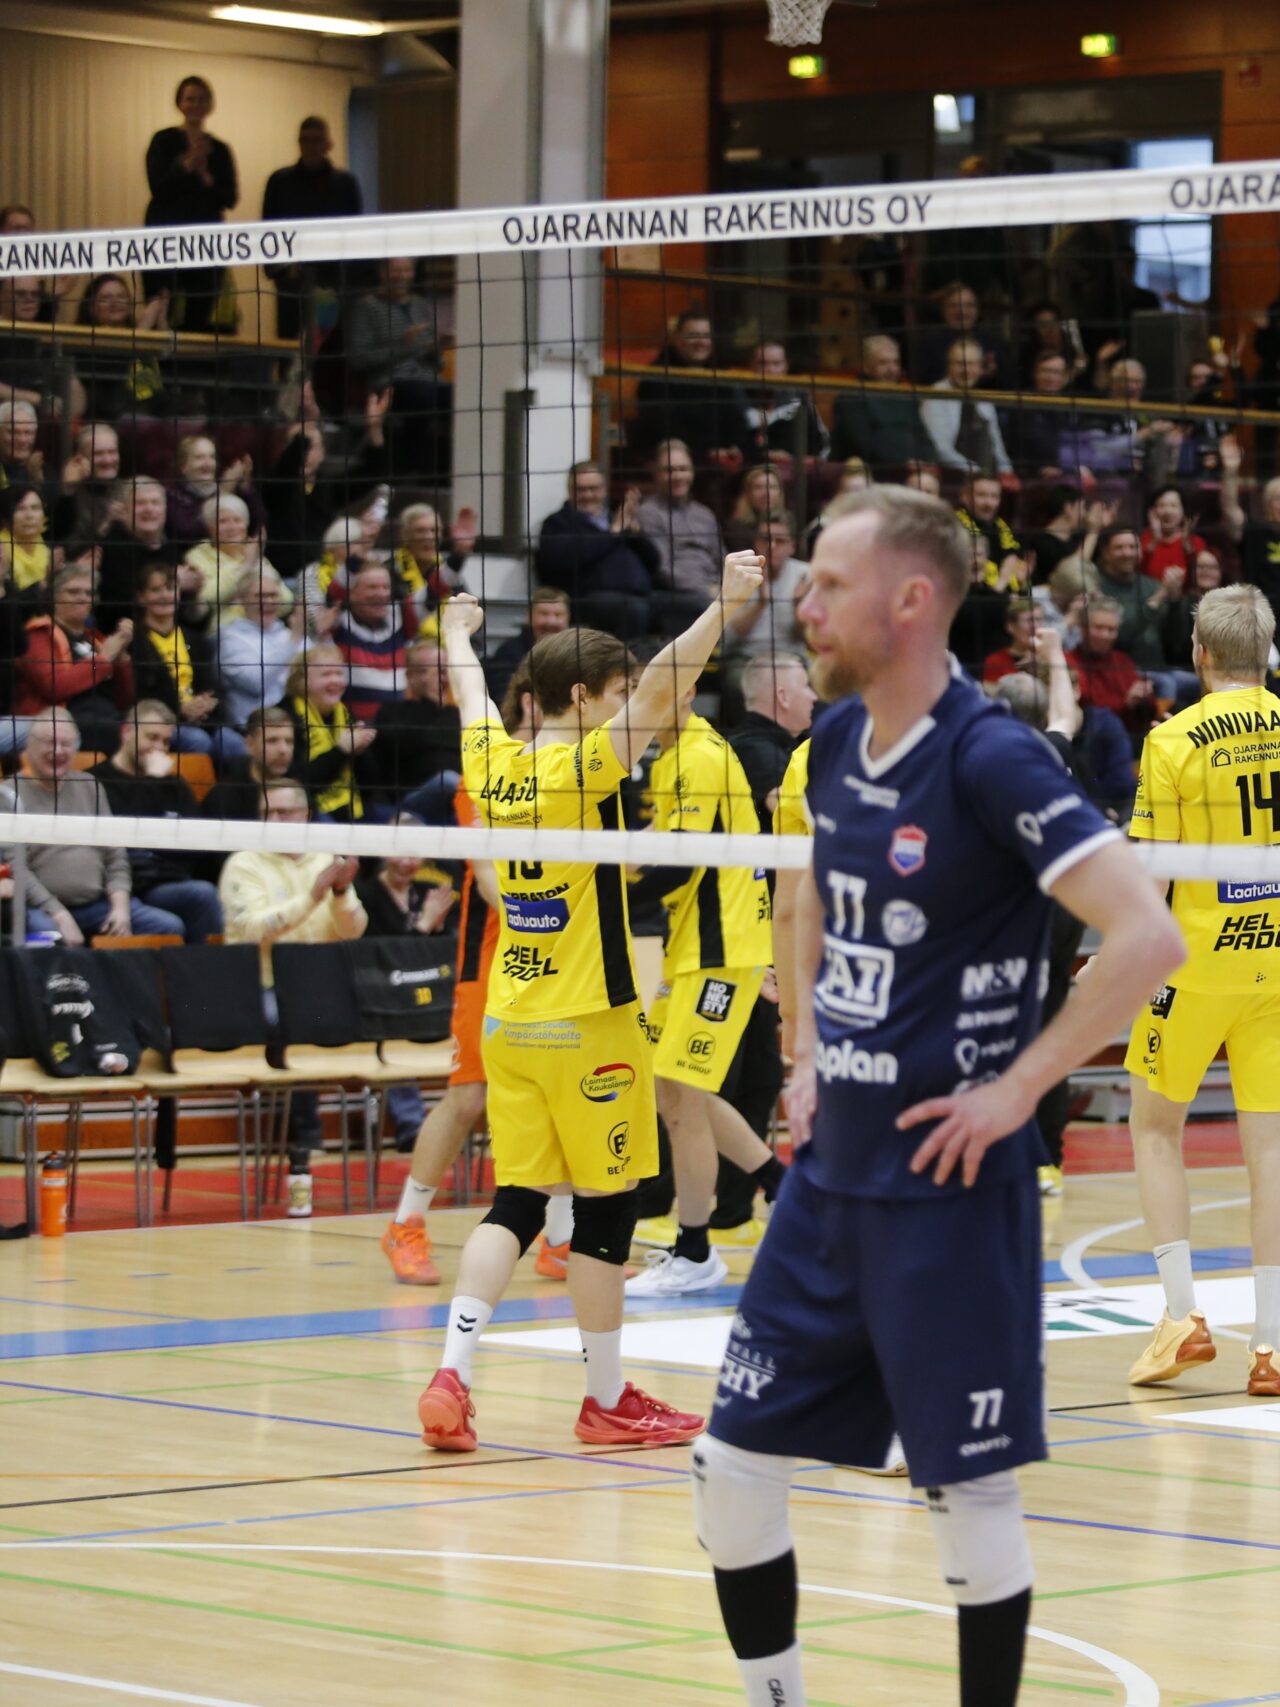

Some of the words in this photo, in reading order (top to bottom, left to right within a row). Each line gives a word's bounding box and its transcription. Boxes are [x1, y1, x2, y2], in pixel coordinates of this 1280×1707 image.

[503, 208, 688, 245] OJARANNAN
[704, 196, 876, 234] RAKENNUS
[887, 194, 932, 224] OY
[0, 241, 93, 270] ANNAN
[107, 231, 251, 267] RAKENNUS
[260, 230, 297, 259] OY
[1221, 912, 1275, 934] HEL
[708, 981, 727, 994] HO
[705, 990, 730, 1004] NEY
[701, 1001, 727, 1014] STY
[690, 1039, 713, 1055] BE
[584, 1075, 617, 1086] Loimaan
[969, 1387, 1004, 1430] 77
